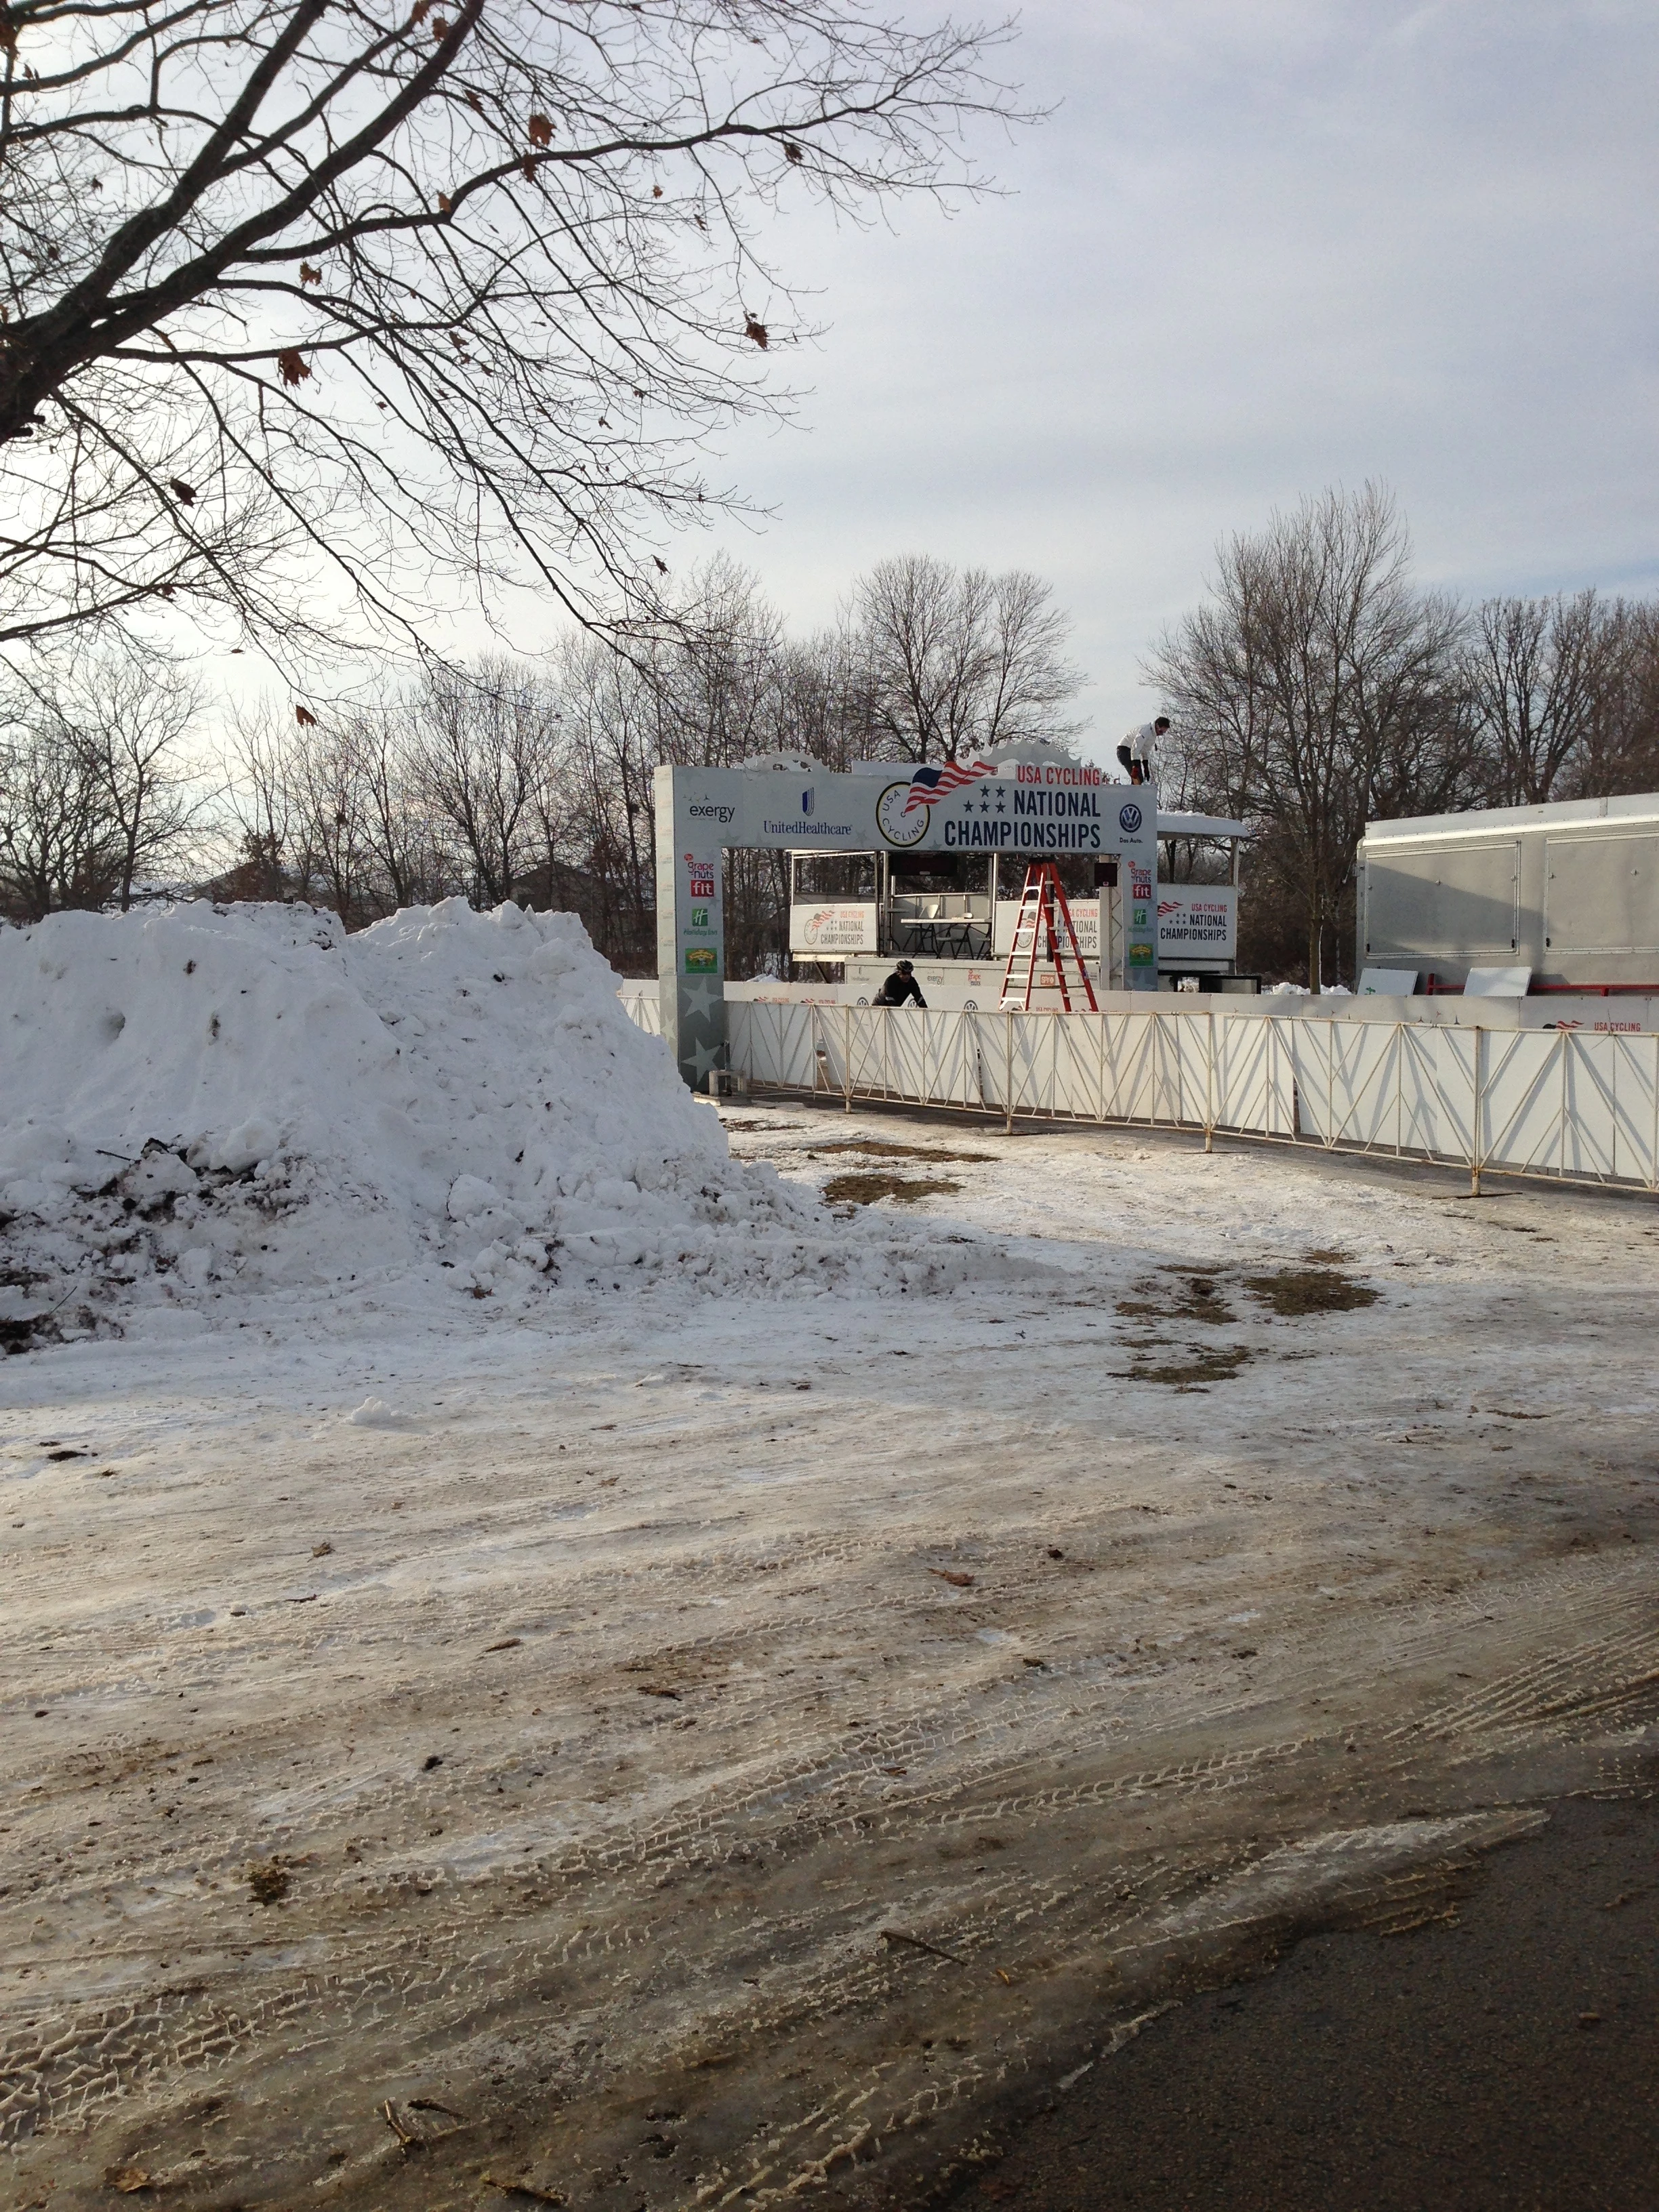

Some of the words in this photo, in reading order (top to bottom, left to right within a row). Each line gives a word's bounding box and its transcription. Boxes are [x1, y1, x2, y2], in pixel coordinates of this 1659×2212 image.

[1017, 765, 1042, 783] USA
[1046, 767, 1101, 786] CYCLING
[882, 790, 901, 812] USA
[1014, 790, 1101, 817] NATIONAL
[689, 805, 735, 823] exergy
[763, 820, 852, 835] UnitedHealthcare
[882, 817, 924, 841] CYCLING
[944, 820, 1101, 848] CHAMPIONSHIPS
[687, 861, 714, 874] grape
[693, 881, 713, 895] fit
[1134, 885, 1150, 897] fit
[1076, 909, 1098, 918] CYCLING
[1191, 903, 1202, 912] USA
[1204, 904, 1227, 913] CYCLING
[839, 921, 864, 932] NATIONAL
[1189, 914, 1227, 926] NATIONAL
[821, 935, 864, 945] CHAMPIONSHIPS
[1160, 928, 1227, 941] CHAMPIONSHIPS
[1595, 1022, 1607, 1031] USA
[1610, 1022, 1641, 1032] CYCLING
